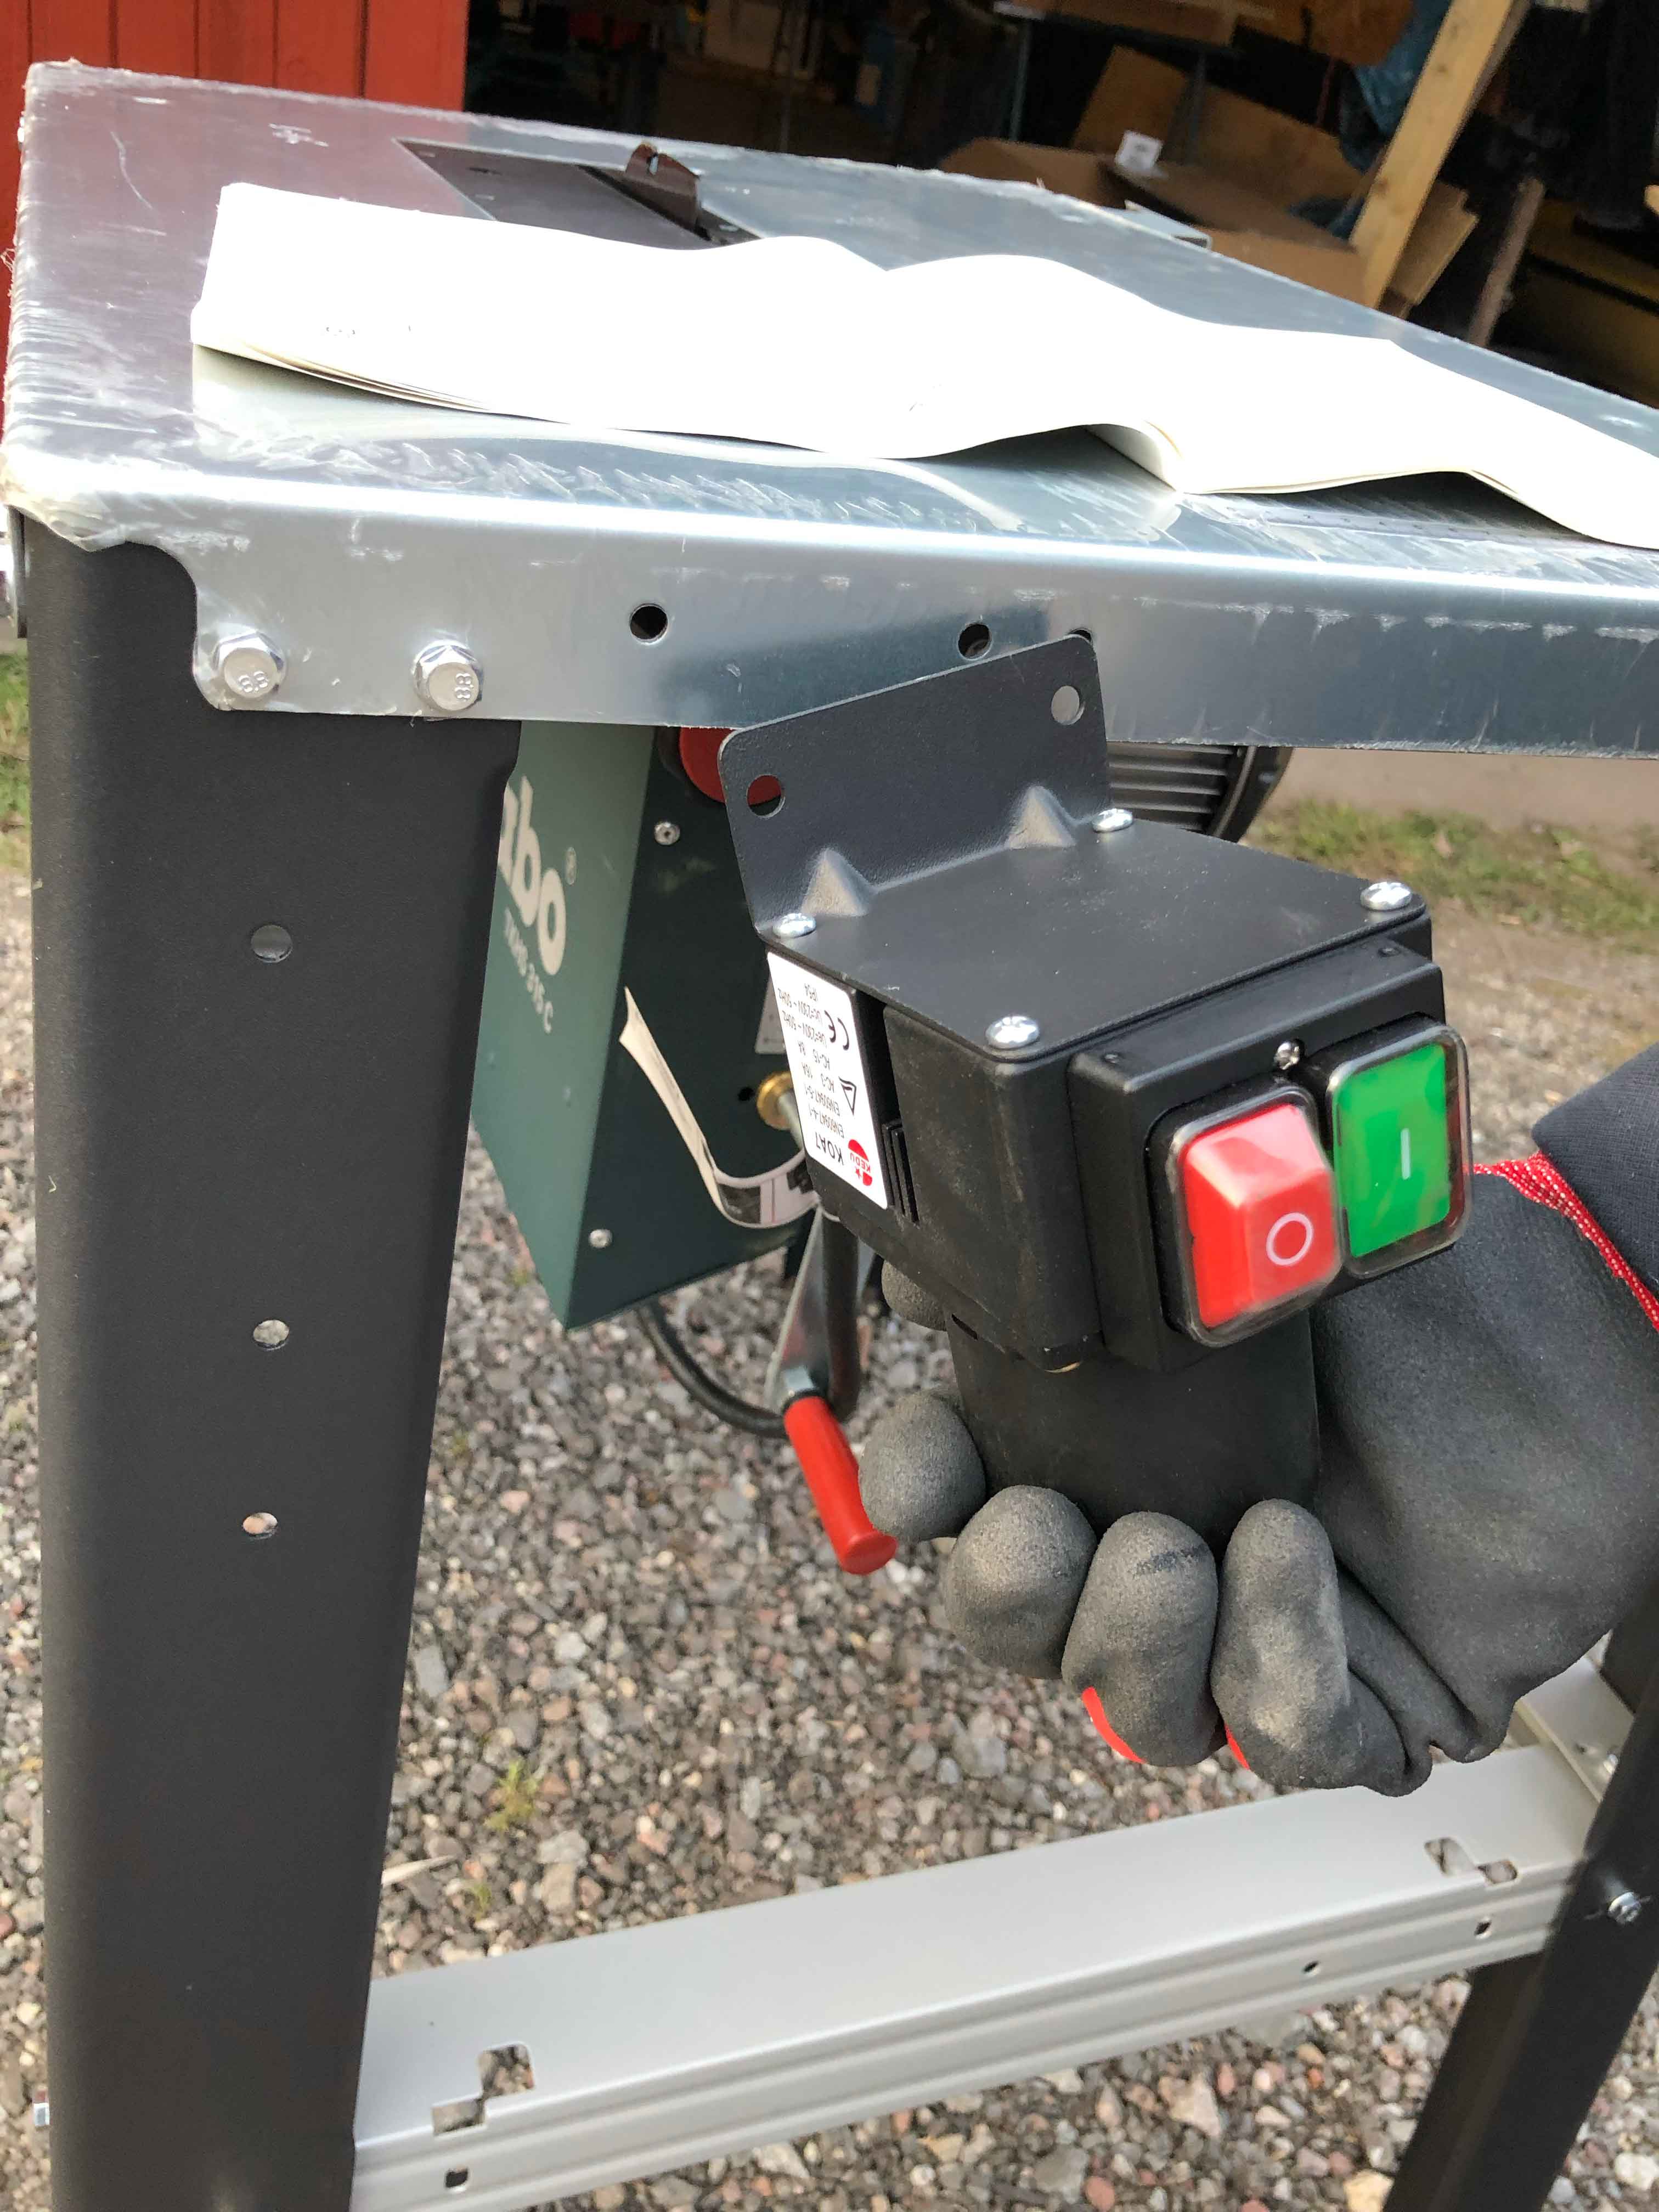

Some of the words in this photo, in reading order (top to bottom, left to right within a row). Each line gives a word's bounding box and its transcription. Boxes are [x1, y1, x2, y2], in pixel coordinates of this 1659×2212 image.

[812, 1048, 830, 1070] AC-15
[801, 1062, 813, 1079] 16A
[820, 1073, 834, 1093] AC-3
[815, 1131, 844, 1166] KOA7
[850, 1153, 871, 1173] KEDU
